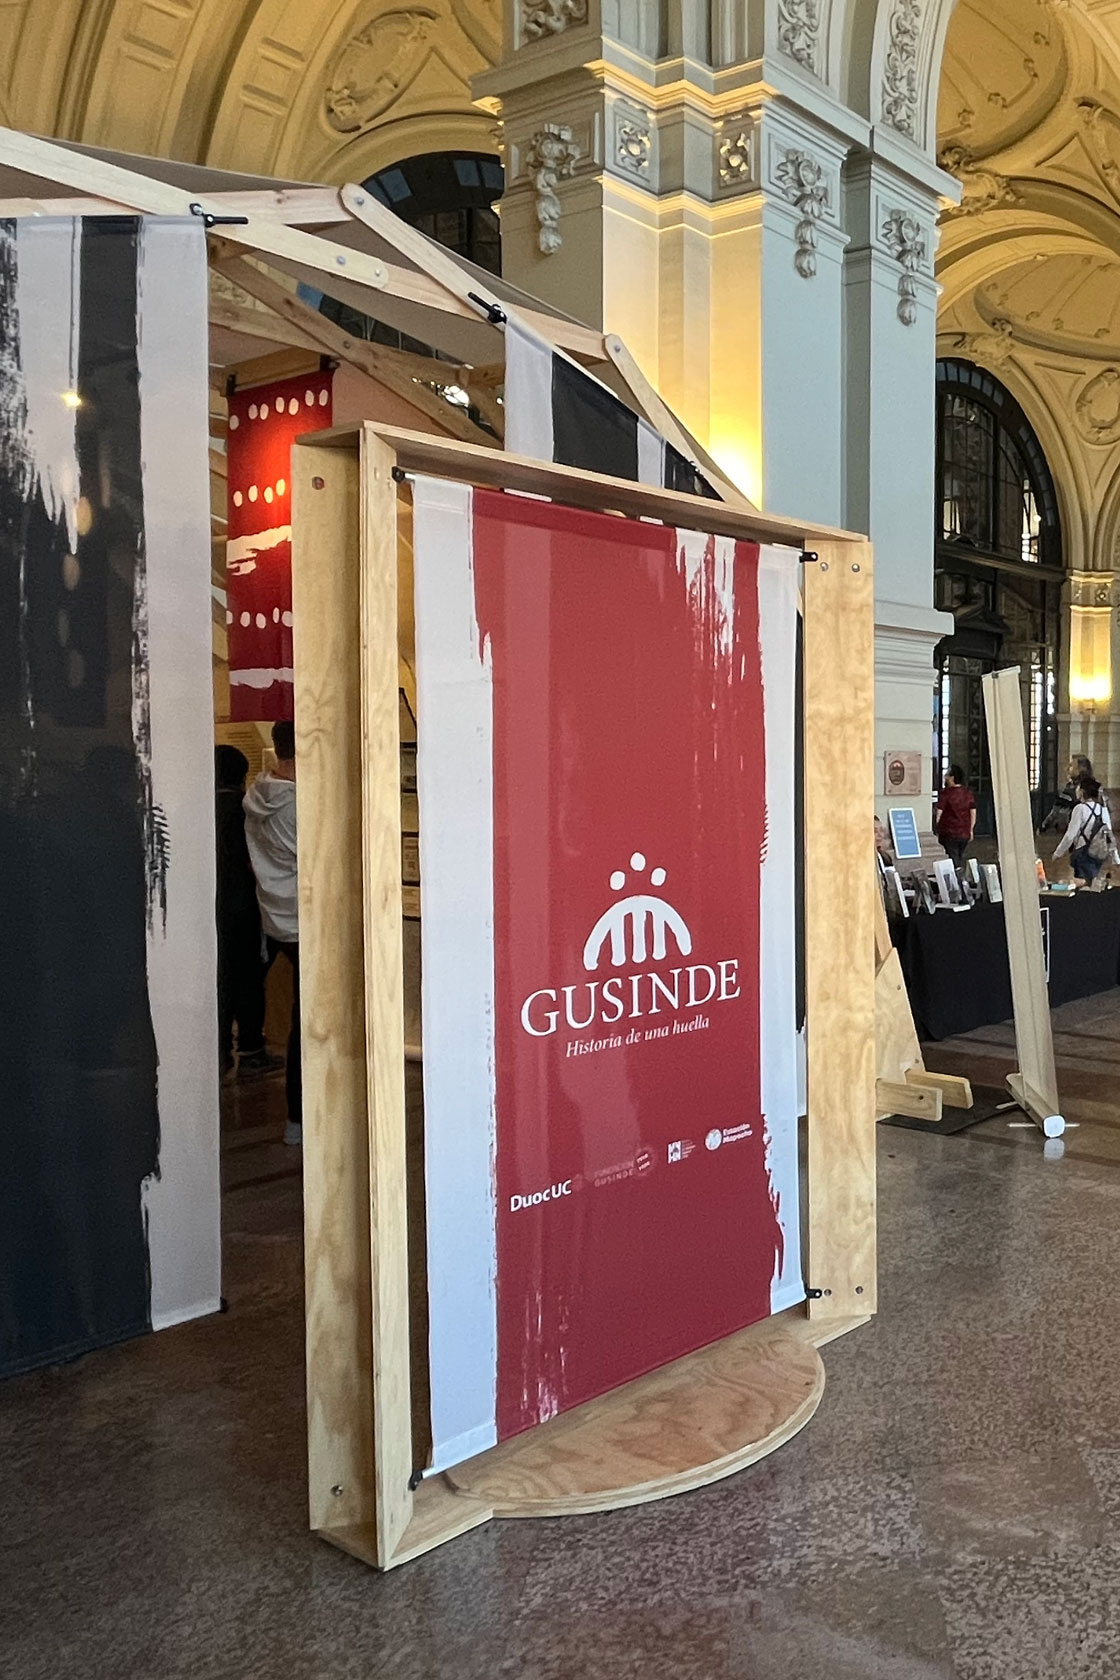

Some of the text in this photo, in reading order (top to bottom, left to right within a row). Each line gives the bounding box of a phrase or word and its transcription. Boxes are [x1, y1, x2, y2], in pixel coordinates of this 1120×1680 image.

[520, 959, 741, 1036] GUSINDE
[566, 1014, 709, 1057] Historia de una huella
